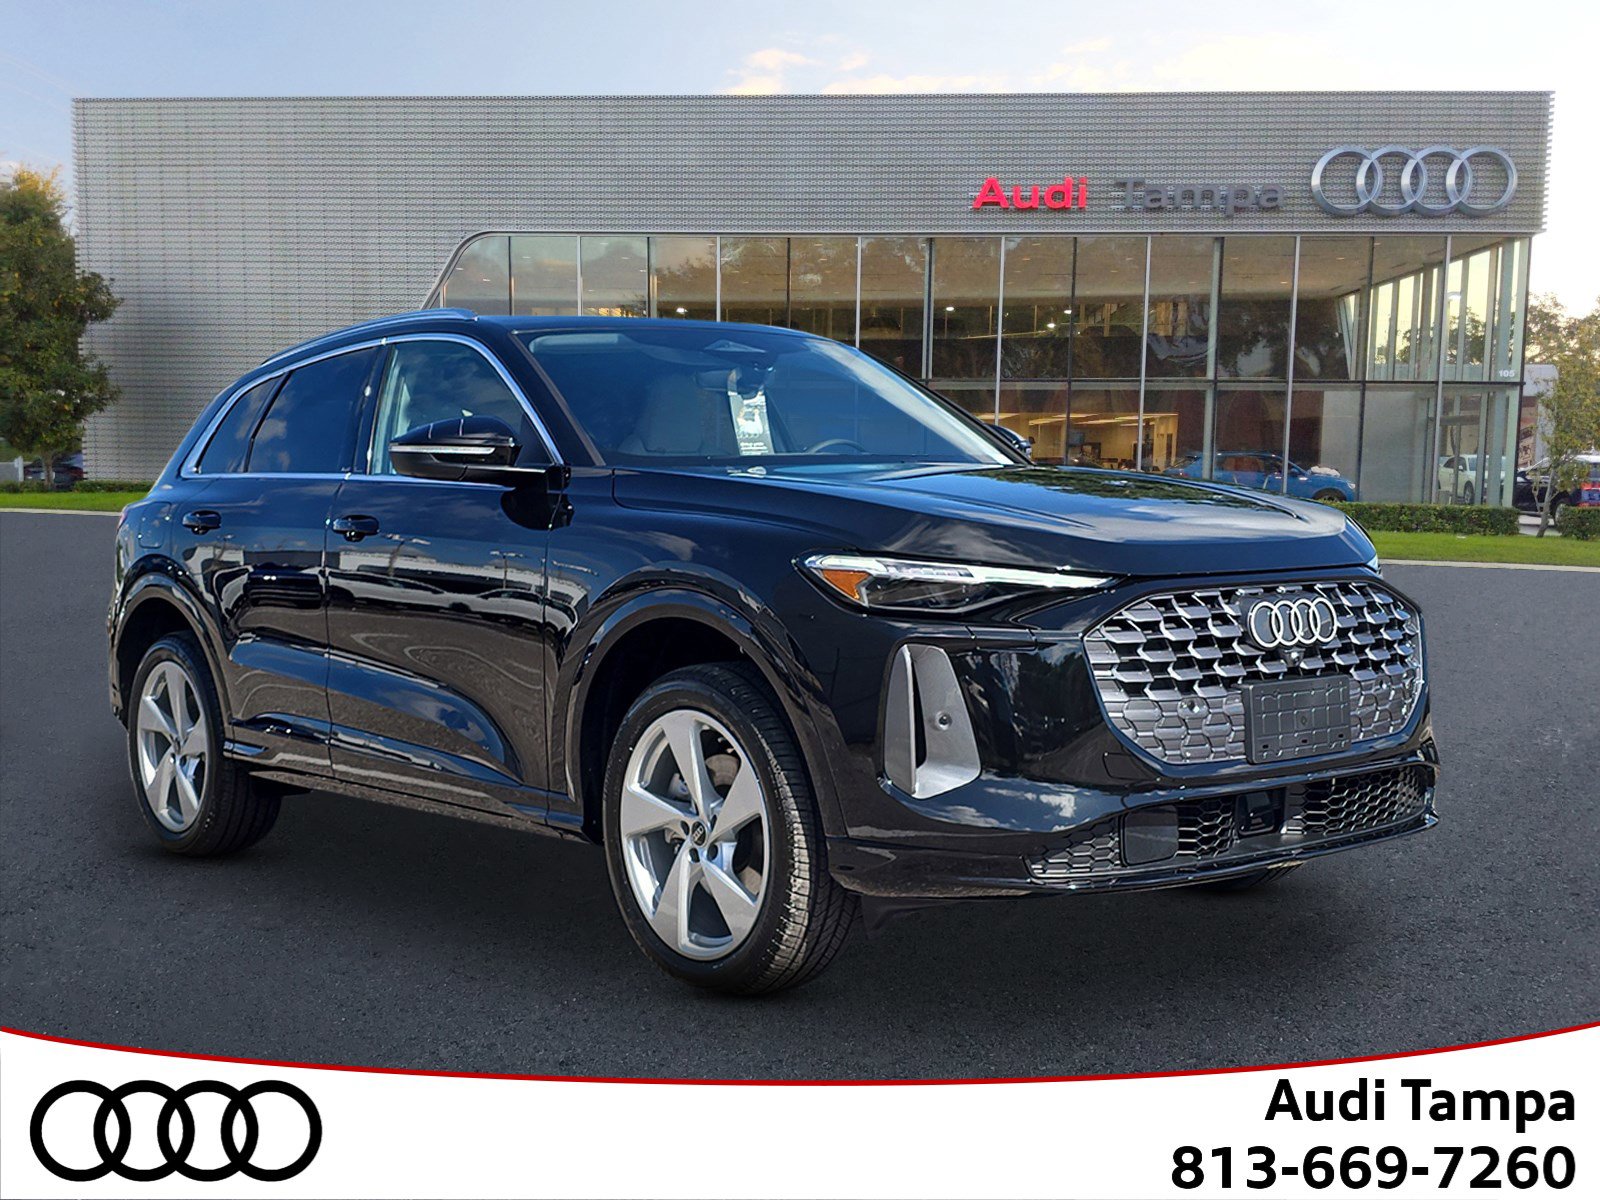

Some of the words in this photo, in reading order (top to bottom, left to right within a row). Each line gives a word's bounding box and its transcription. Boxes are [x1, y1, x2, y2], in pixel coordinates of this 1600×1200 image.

[972, 176, 1088, 210] Audi
[1114, 177, 1286, 218] Tampa
[1498, 369, 1516, 378] 105
